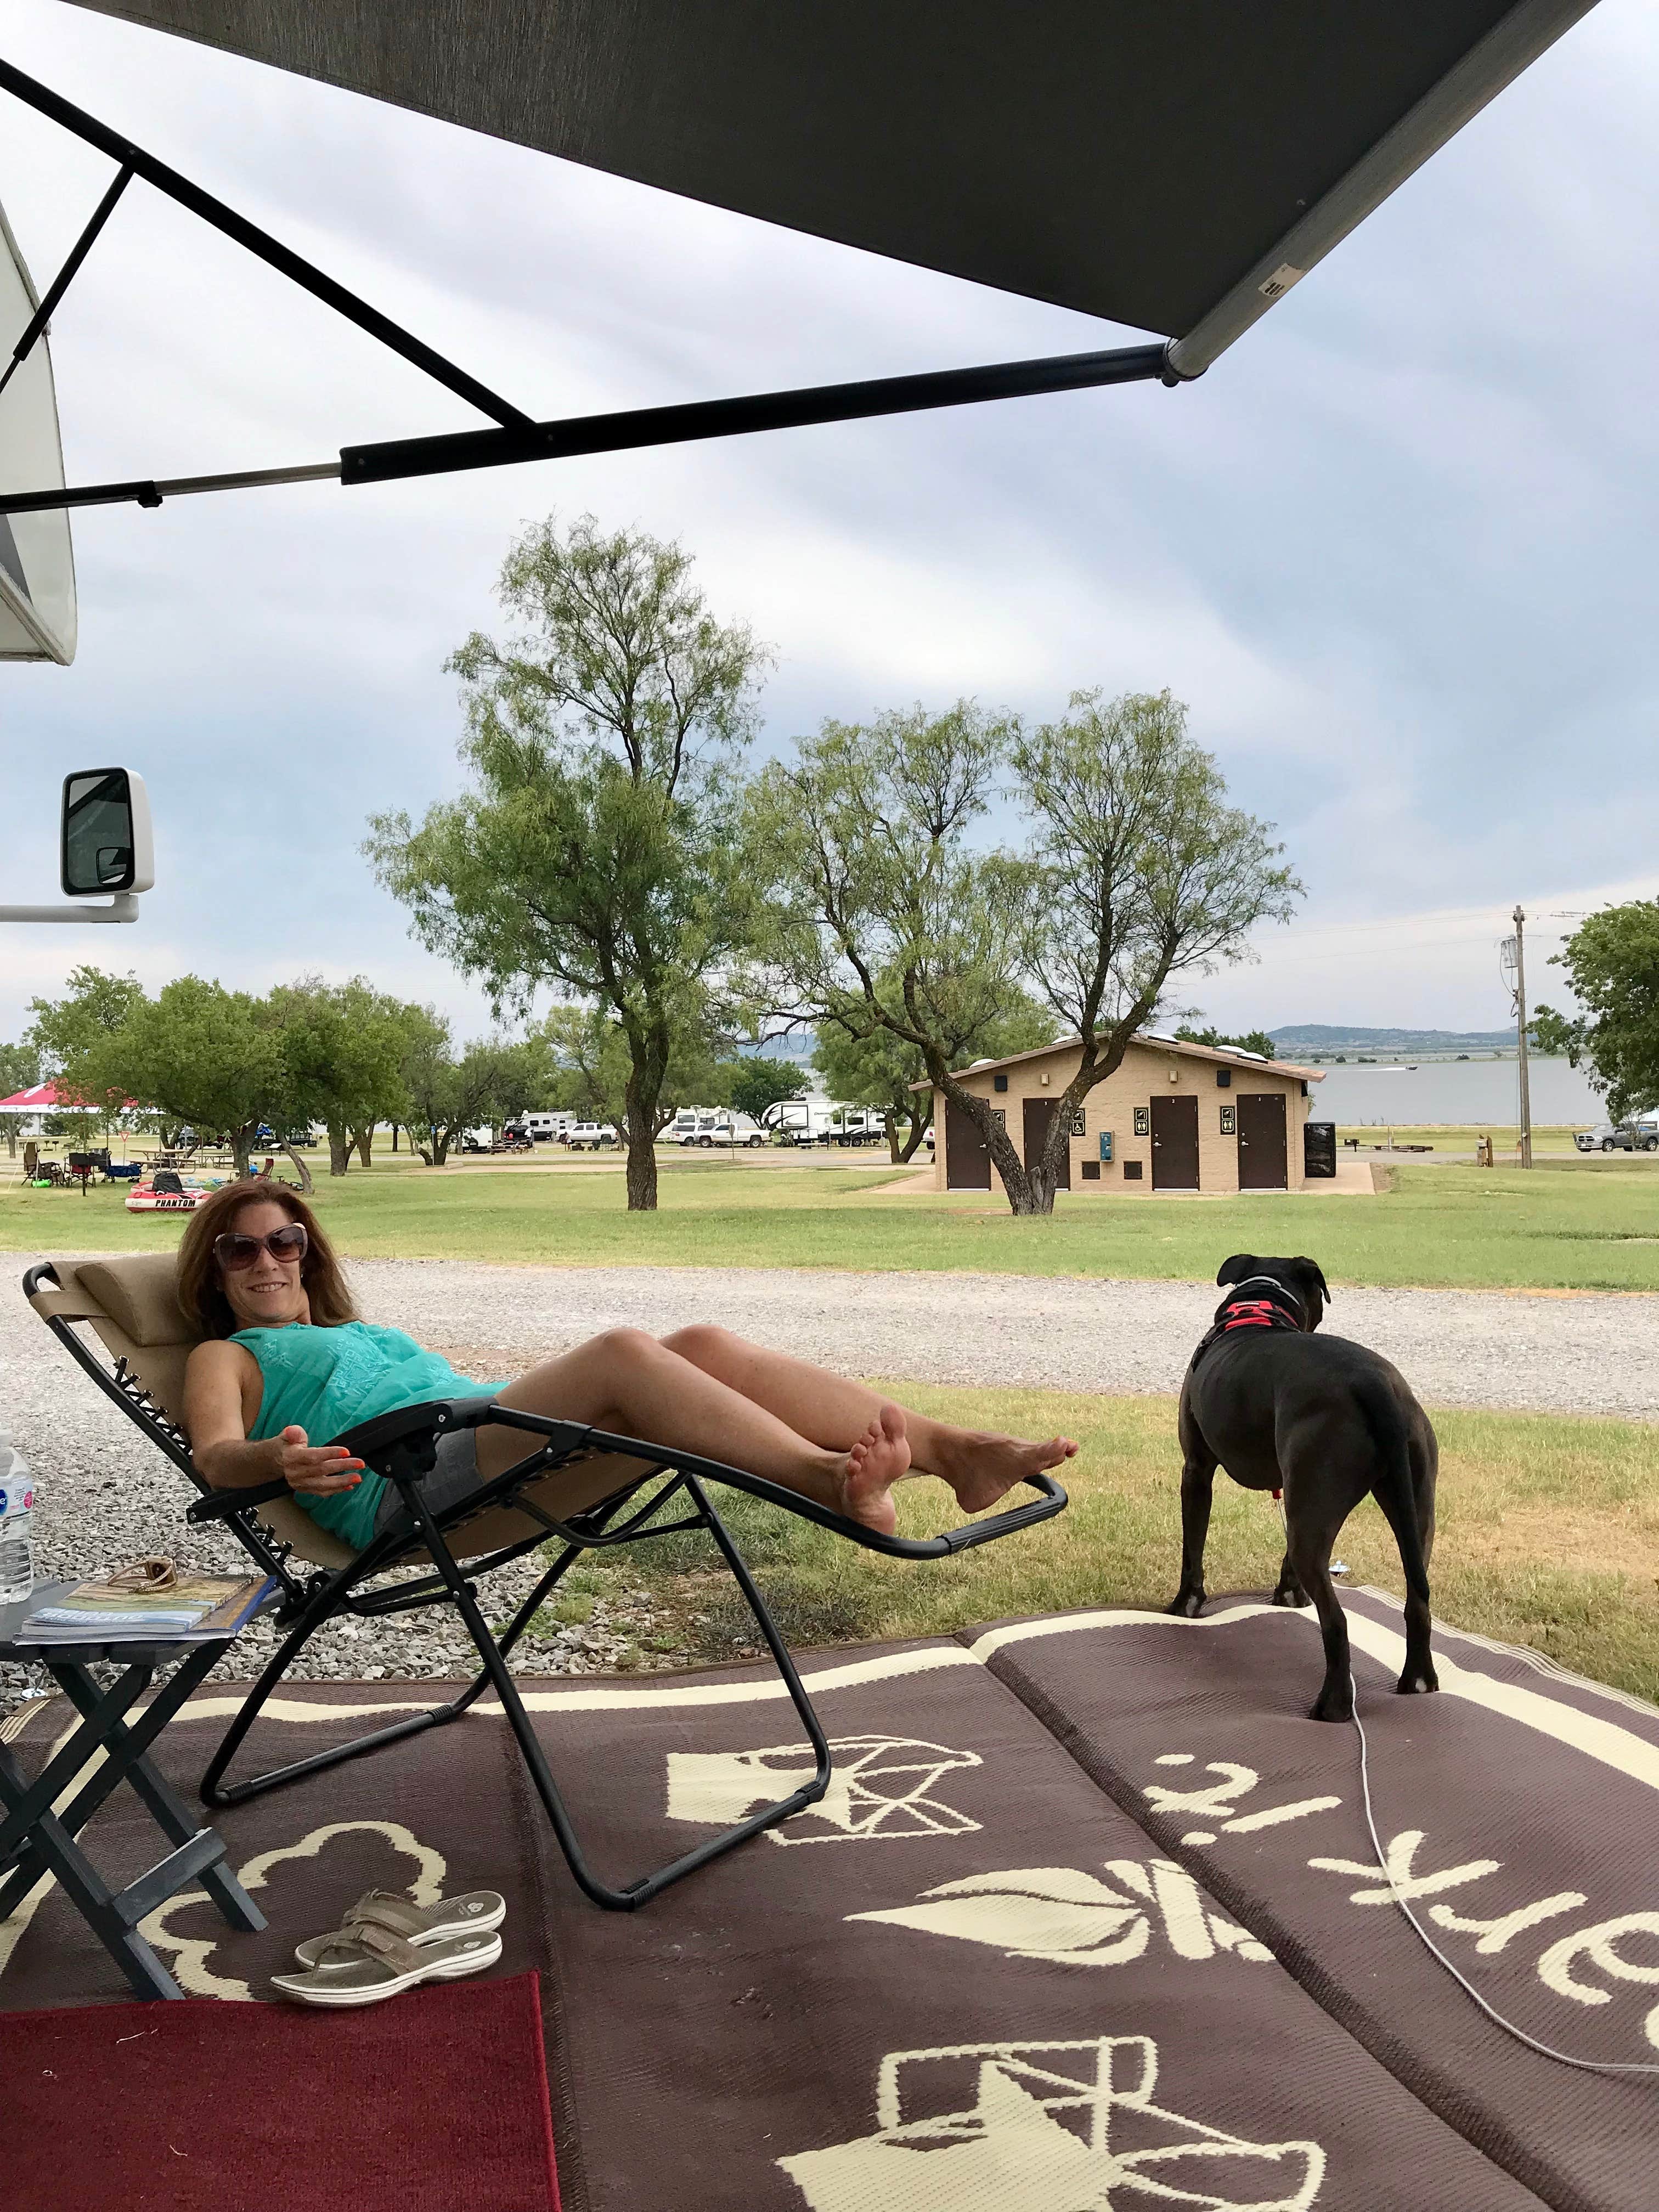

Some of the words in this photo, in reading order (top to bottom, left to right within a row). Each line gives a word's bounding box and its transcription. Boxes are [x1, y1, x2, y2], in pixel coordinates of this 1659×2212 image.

[42, 1612, 144, 1621] OUTDOOR
[1142, 1754, 1342, 1845] it.
[1307, 1831, 1659, 2048] ark
